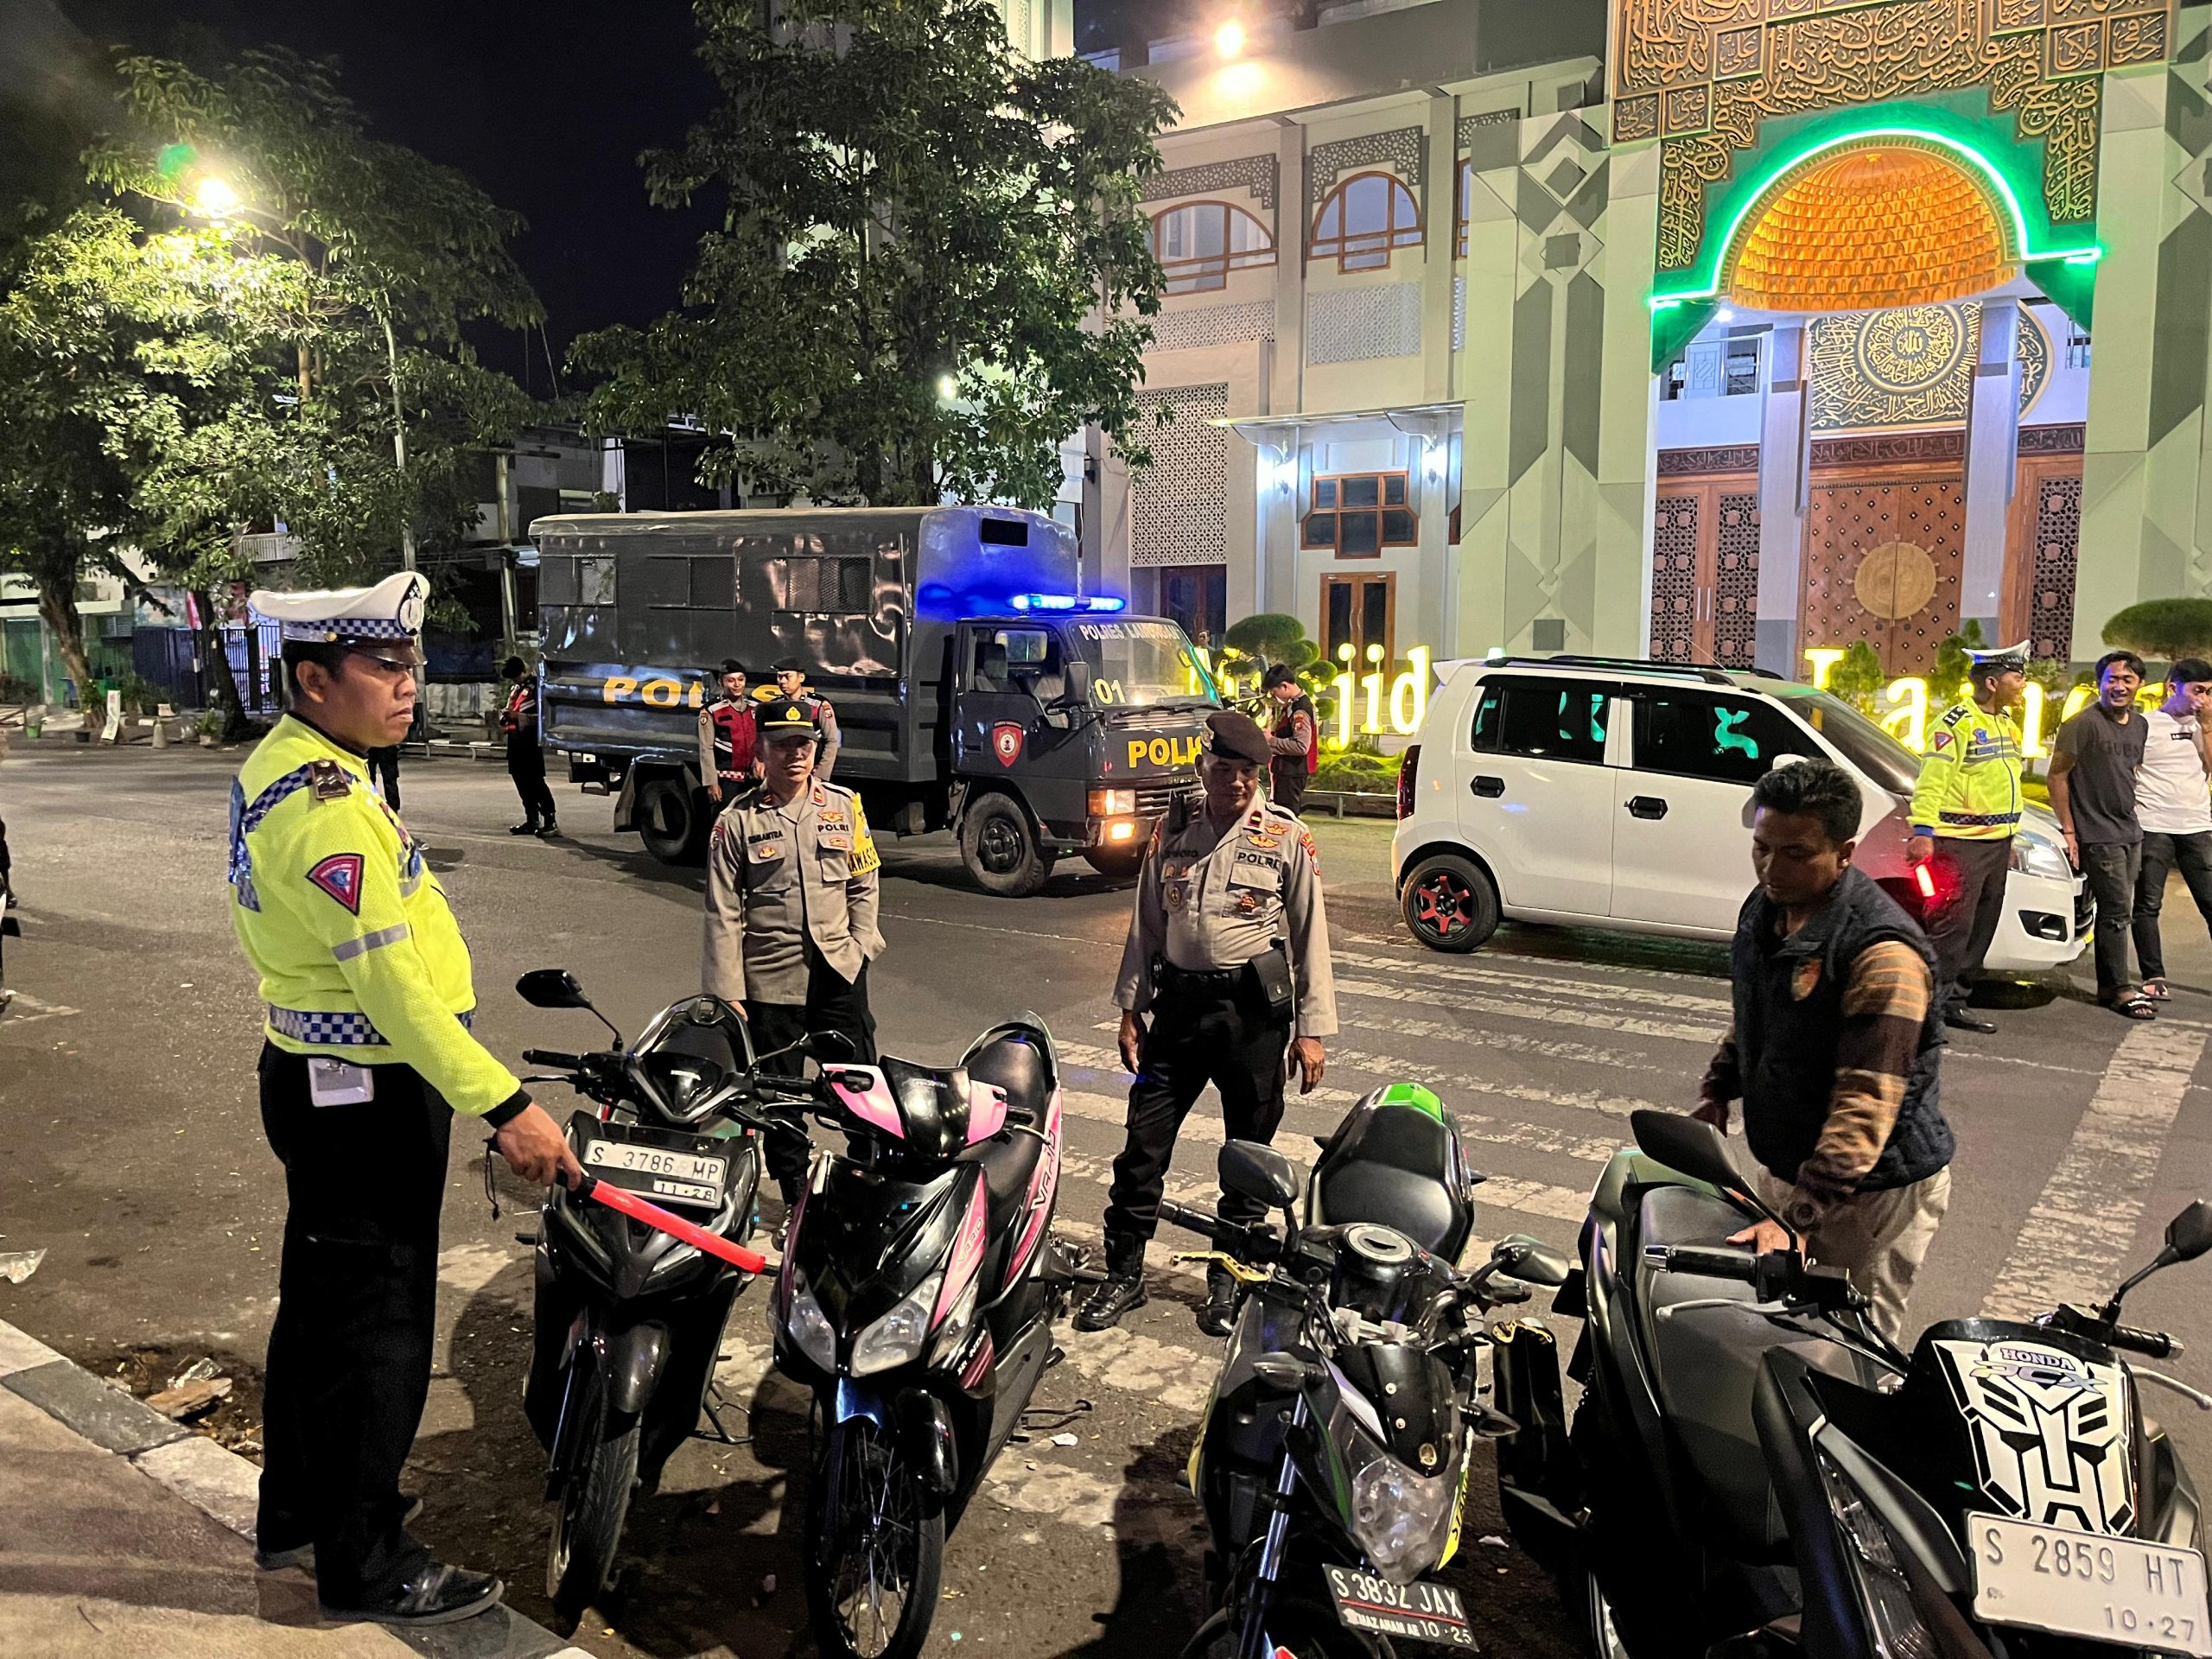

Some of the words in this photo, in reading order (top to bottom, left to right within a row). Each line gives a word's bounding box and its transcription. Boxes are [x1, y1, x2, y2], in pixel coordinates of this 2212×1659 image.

[1094, 678, 1126, 705] 01
[817, 823, 849, 833] POLRI
[592, 1147, 604, 1163] S
[623, 1151, 675, 1173] 3786
[2000, 1348, 2075, 1371] HONDA
[1969, 1359, 2109, 1395] PCX
[1986, 1528, 2004, 1565] S
[2031, 1535, 2115, 1584] 2859
[2145, 1554, 2184, 1598] HT
[1331, 1568, 1350, 1598] S
[1420, 1585, 1464, 1619] JAX
